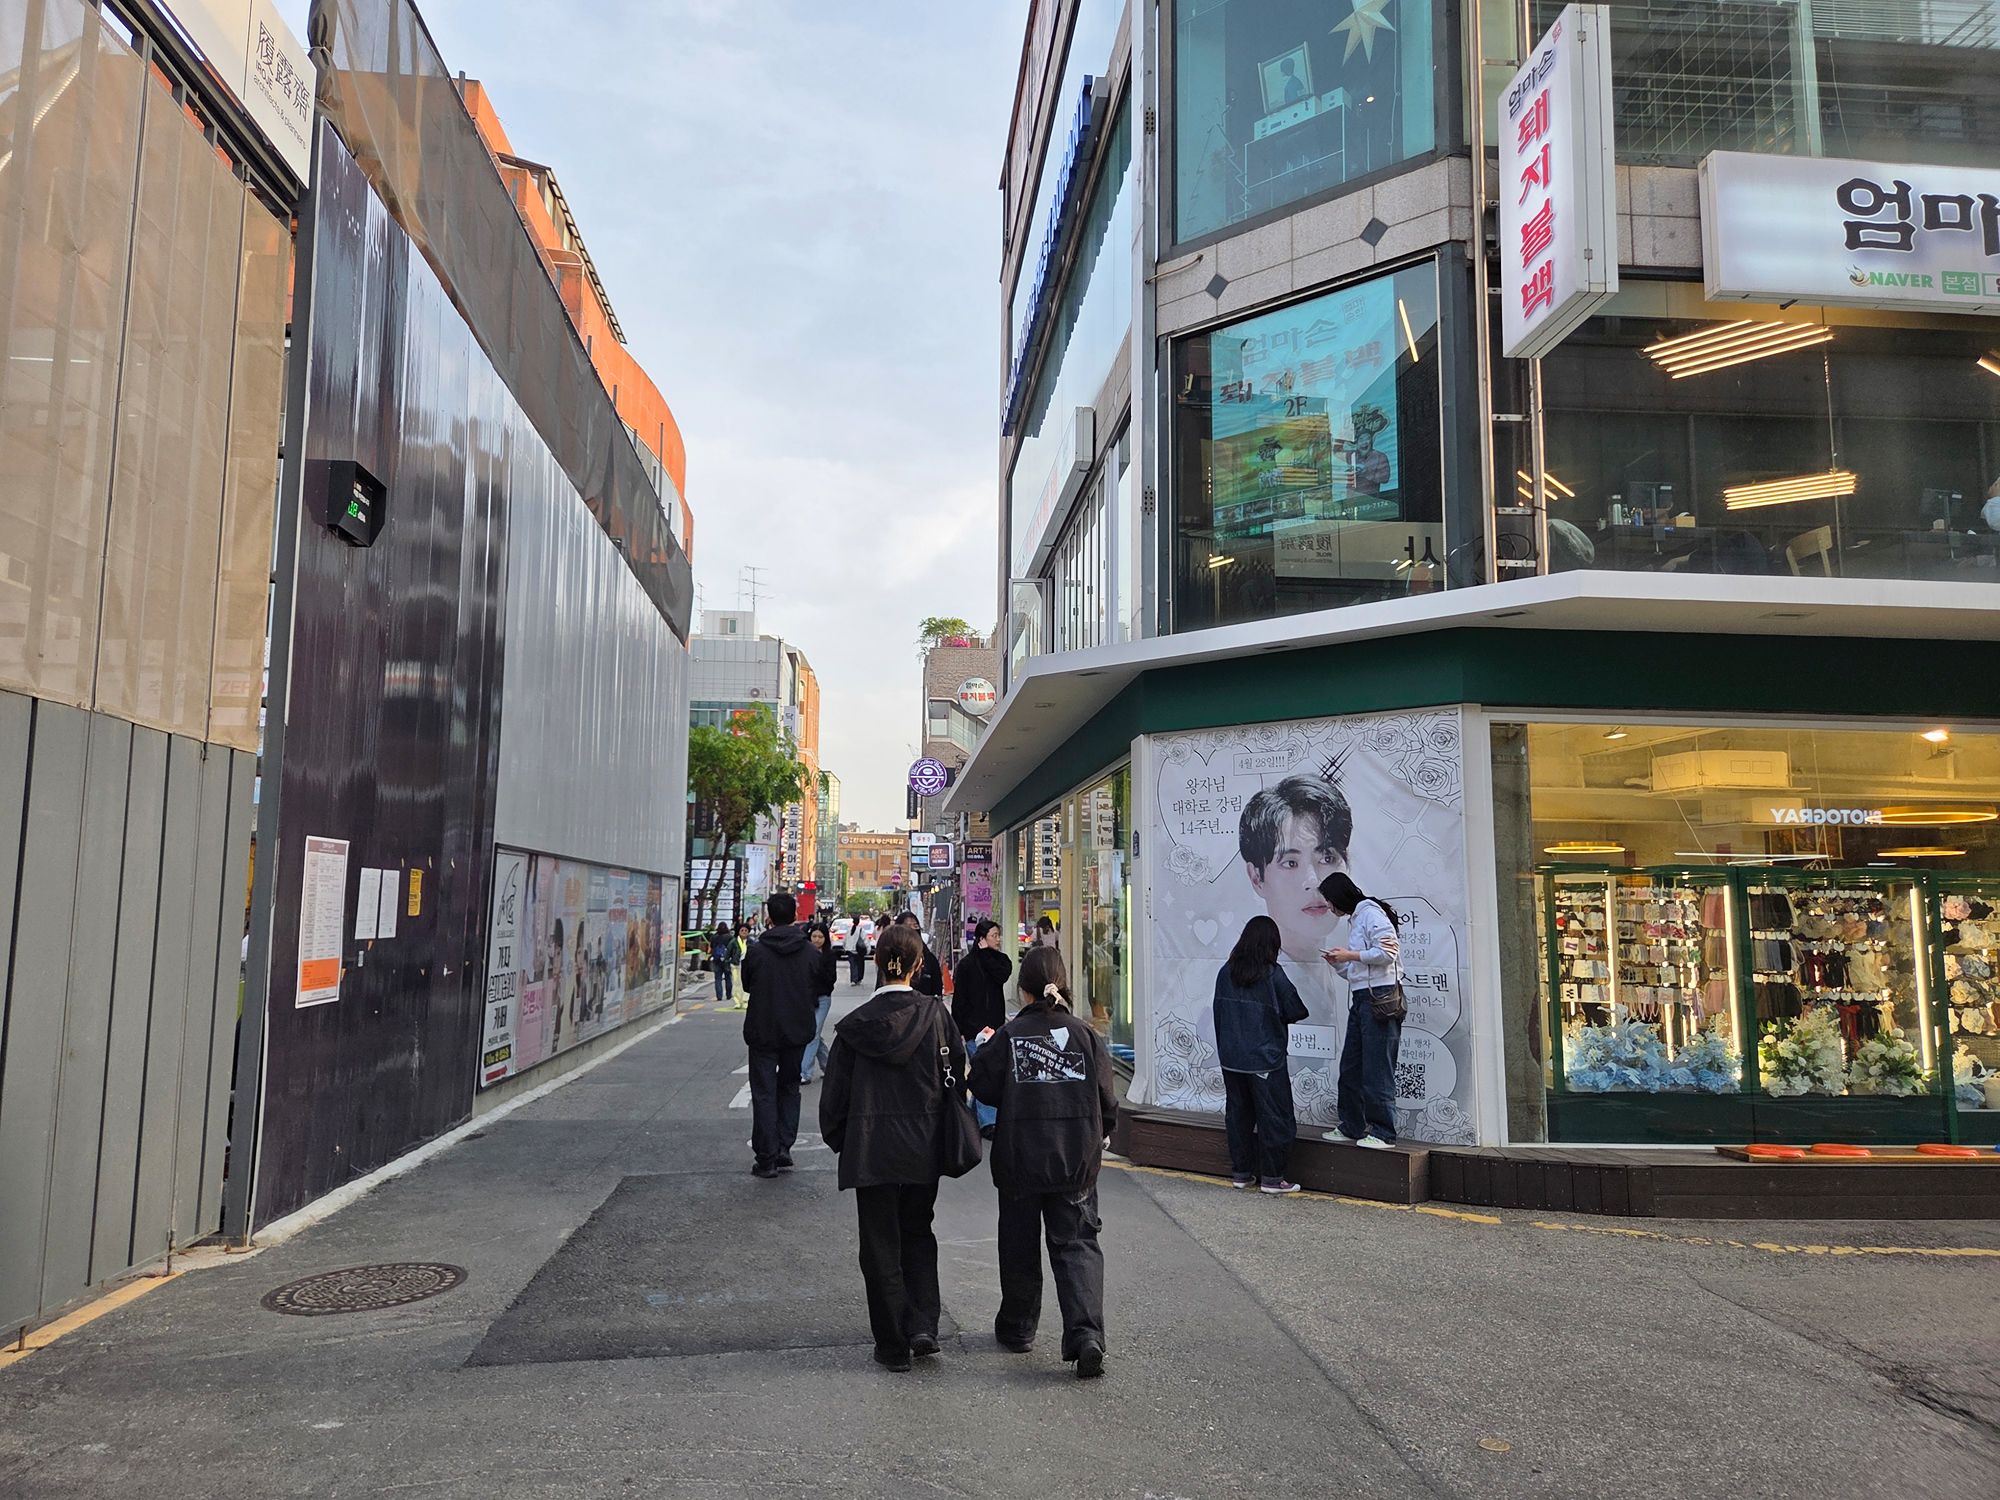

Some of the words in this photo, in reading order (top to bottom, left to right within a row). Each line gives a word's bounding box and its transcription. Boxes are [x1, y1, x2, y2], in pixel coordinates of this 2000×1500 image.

[1509, 50, 1553, 120] 엄마손
[1518, 88, 1555, 319] 돼지불백
[1870, 272, 1934, 288] NAVER
[1944, 275, 1976, 291] 본점
[1244, 318, 1338, 366] 엄마손
[1284, 396, 1308, 418] 2F
[1255, 756, 1285, 768] 28일!!!
[1186, 776, 1225, 795] 왕자님
[1173, 799, 1212, 816] 대학로
[1216, 795, 1242, 813] 강림
[1180, 818, 1234, 835] 14주년...
[787, 807, 799, 875] 도토리씨어터
[1404, 948, 1426, 961] 24일
[1024, 1041, 1058, 1060] EVERYTHING
[1290, 1033, 1331, 1051] 방법...
[1028, 1051, 1047, 1064] GOING
[1047, 1059, 1055, 1067] TO
[1054, 1063, 1062, 1071] BE
